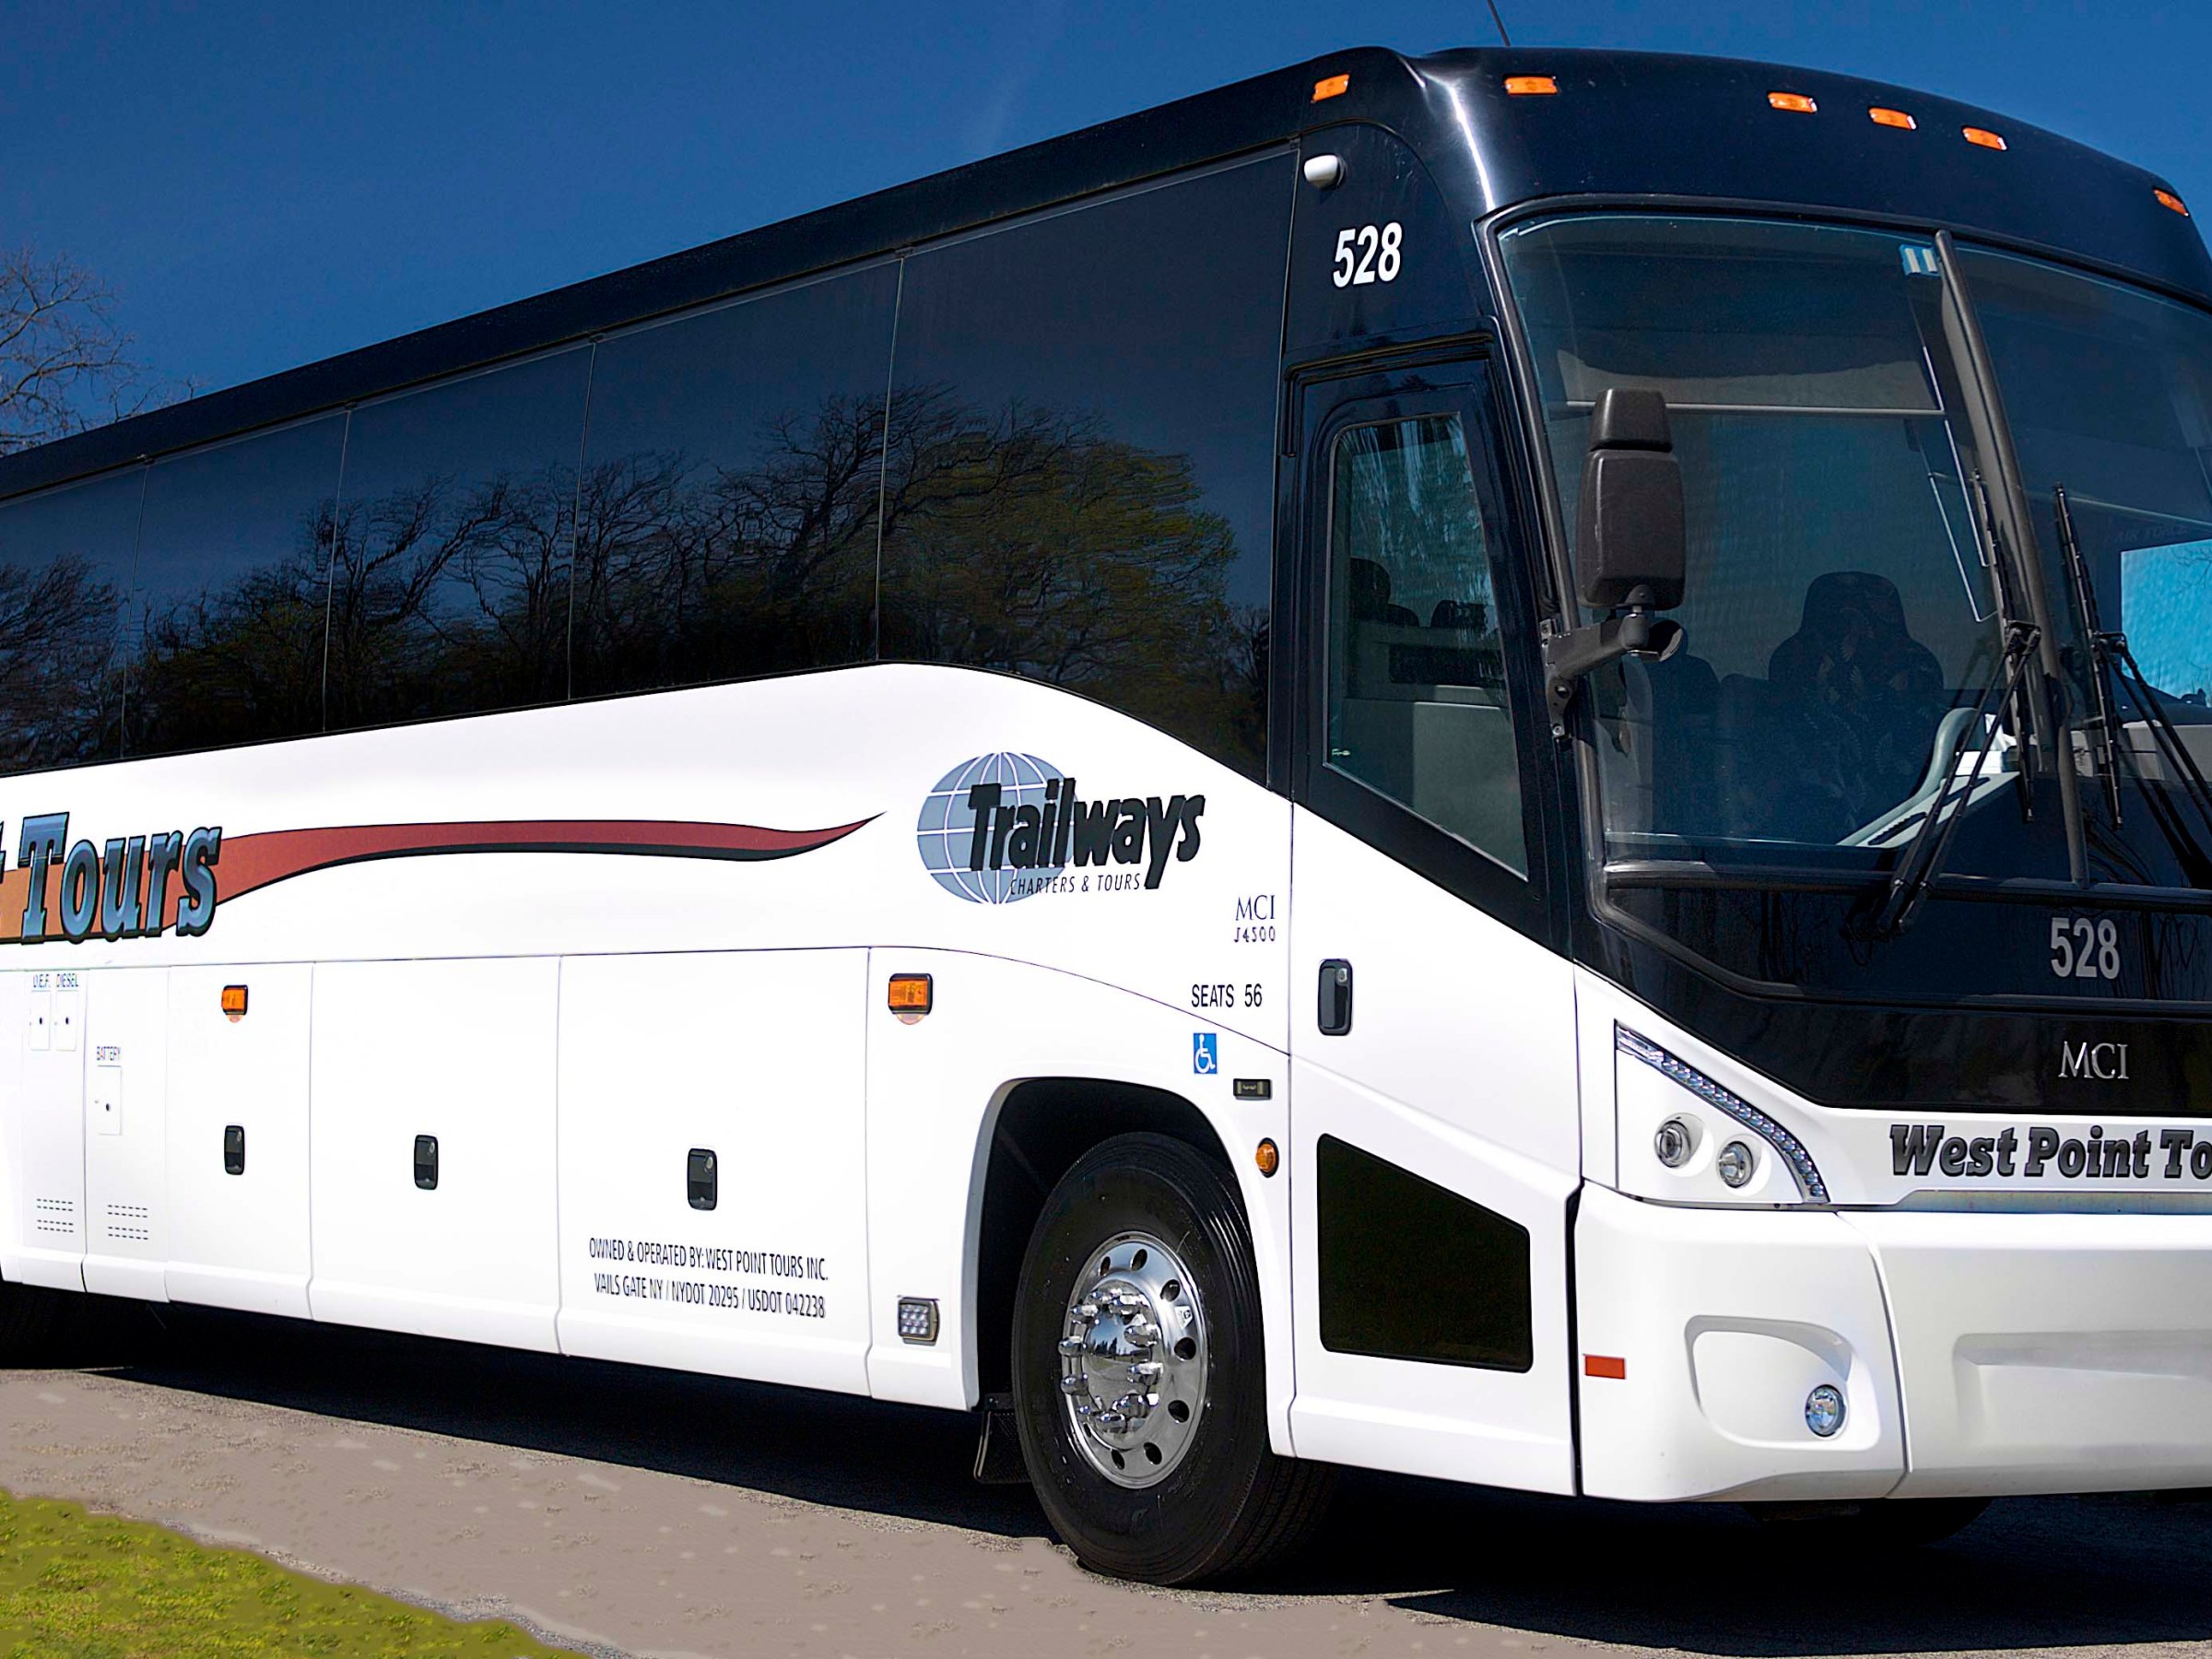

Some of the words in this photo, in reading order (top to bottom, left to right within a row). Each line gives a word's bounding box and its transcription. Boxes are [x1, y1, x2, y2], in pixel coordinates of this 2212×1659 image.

[1333, 222, 1403, 288] 528
[968, 777, 1206, 890] Trailways
[18, 811, 223, 946] Tours
[1011, 877, 1076, 894] CHARTERS
[1081, 876, 1089, 892] &
[1098, 873, 1140, 891] TOURS
[1235, 895, 1276, 921] MCI
[1233, 925, 1276, 943] J4500
[2051, 917, 2120, 980] 528
[1192, 983, 1234, 1008] SEATS
[1244, 982, 1263, 1008] 56
[2058, 1041, 2129, 1079] MCI
[1889, 1124, 2018, 1177] West
[2023, 1125, 2151, 1179] Point
[589, 1237, 625, 1261] OWNED
[627, 1241, 635, 1262] &
[637, 1241, 687, 1267] OPERATED
[736, 1250, 767, 1275] POINT
[770, 1253, 804, 1279] TOURS
[806, 1256, 829, 1281] INC.
[594, 1273, 620, 1296] VAILS
[622, 1275, 647, 1299] GATE
[649, 1277, 663, 1300] NY
[671, 1280, 705, 1305] NYDOT
[709, 1284, 739, 1309] 20295
[747, 1288, 782, 1313] USDOT
[785, 1292, 826, 1319] 042238
